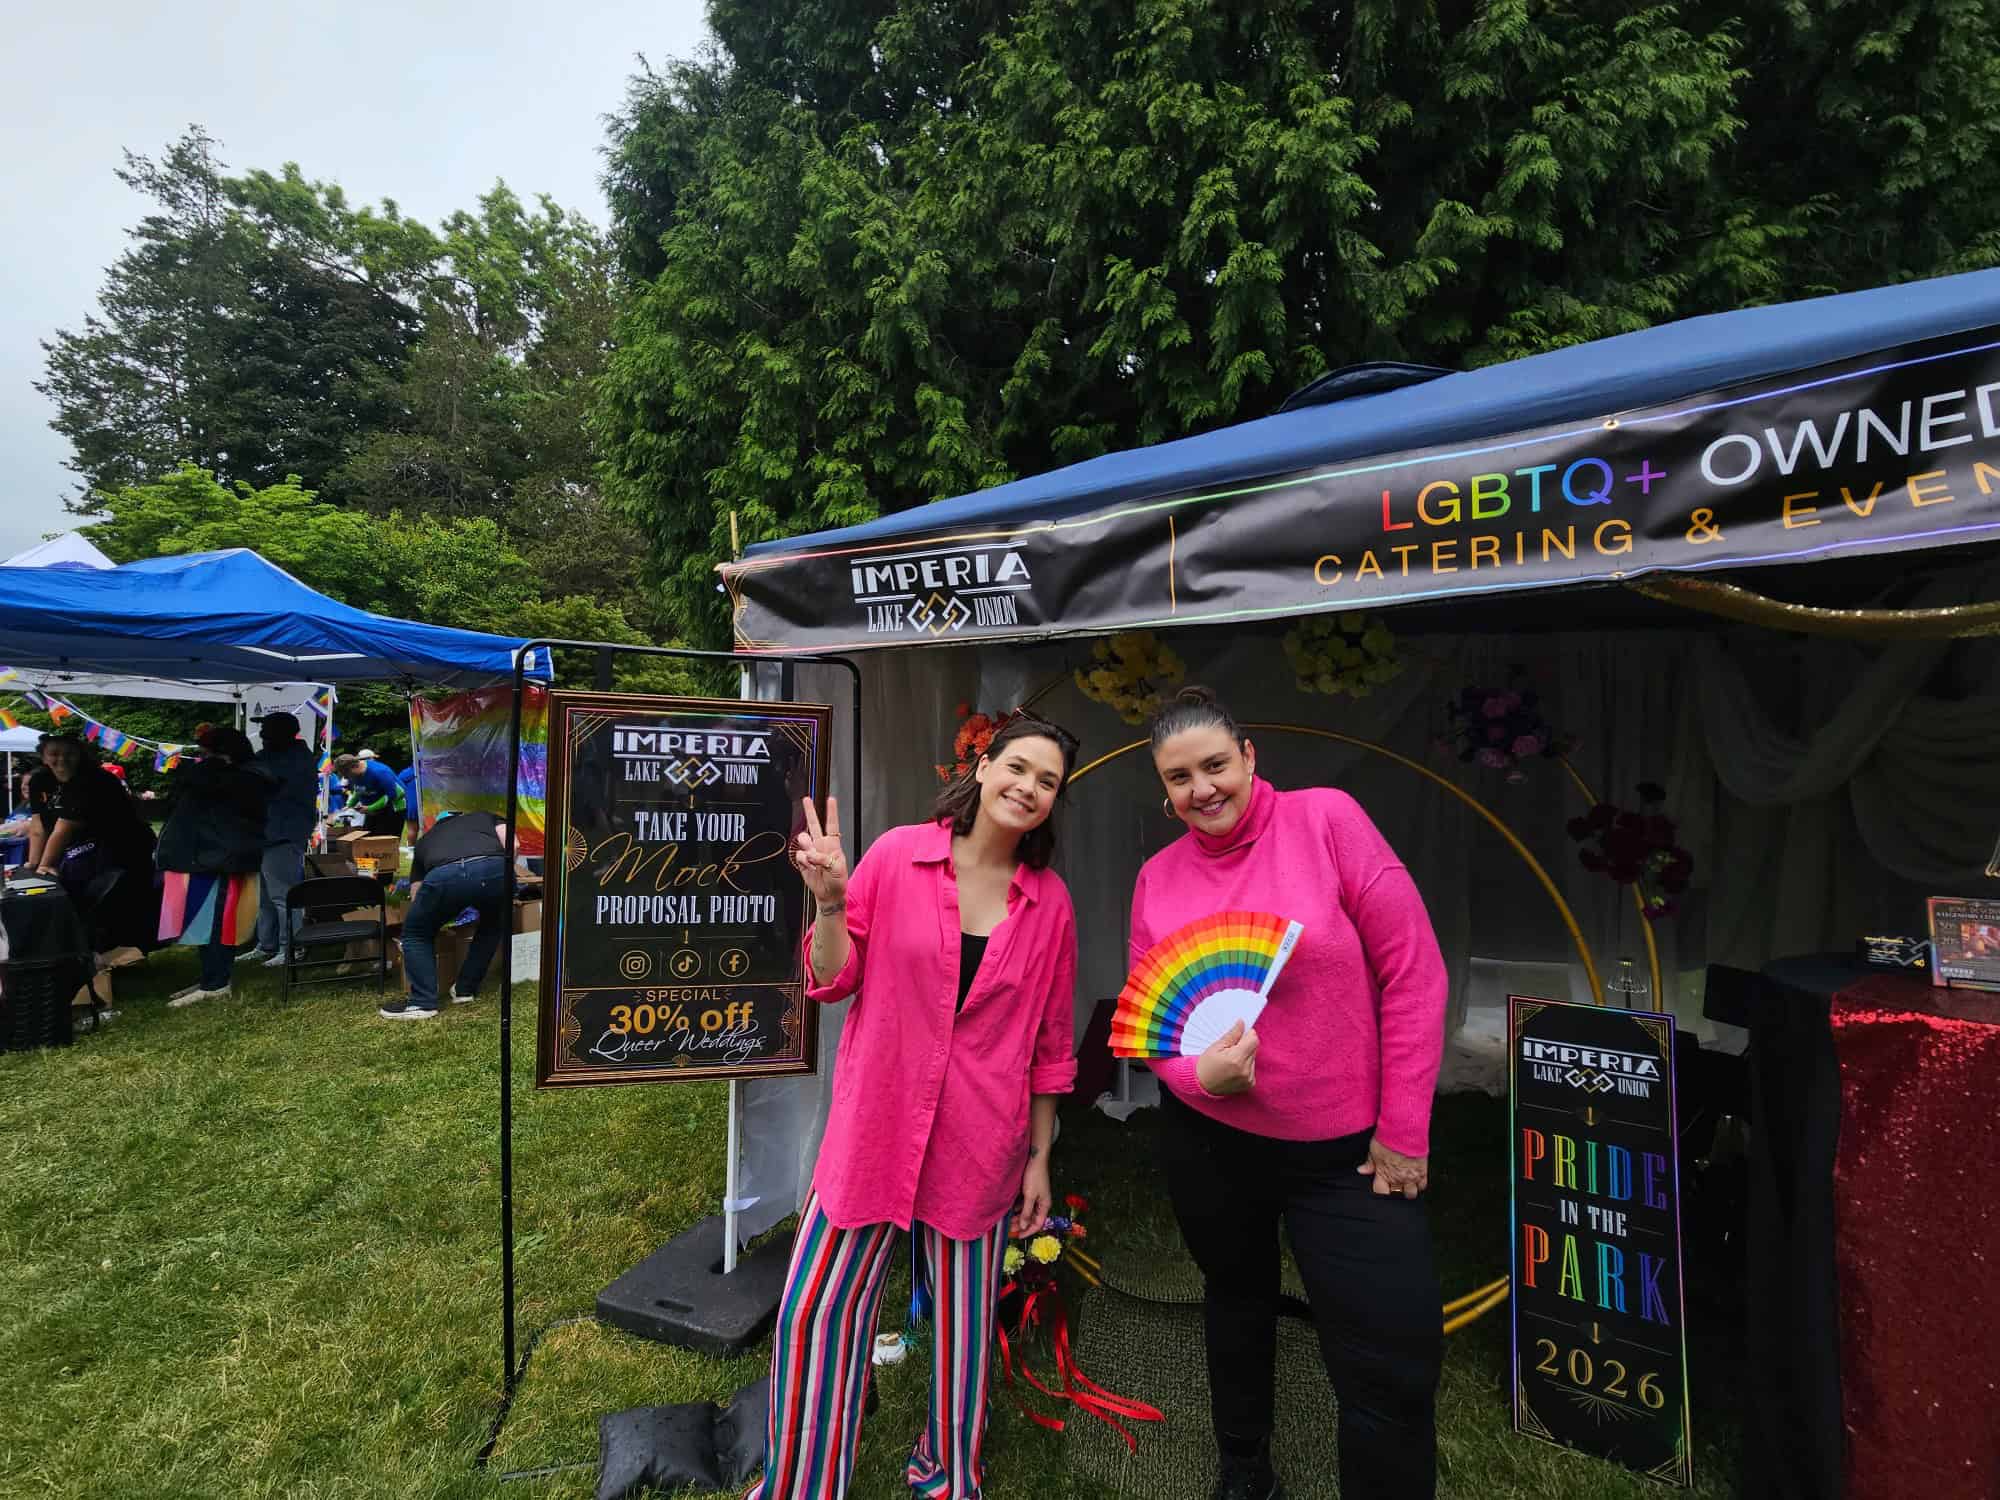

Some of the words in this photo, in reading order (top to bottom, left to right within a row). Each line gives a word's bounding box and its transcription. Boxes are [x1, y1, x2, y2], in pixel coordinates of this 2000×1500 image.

[1381, 457, 1667, 532] LGBTQ+
[1314, 519, 1633, 585] CATERING
[1685, 508, 1726, 545] &
[851, 552, 1032, 594] IMPERIA
[867, 604, 903, 633] LAKE
[974, 595, 1018, 626] UNION
[613, 731, 771, 757] IMPERIA
[624, 760, 660, 782] LAKE
[724, 764, 760, 785] UNION
[634, 811, 688, 841] TAKE
[696, 812, 746, 842] YOUR
[590, 831, 787, 893] Mock
[595, 895, 701, 925] PROPOSAL
[709, 895, 776, 924] PHOTO
[646, 988, 721, 1002] SPECIAL
[608, 1004, 690, 1034] 30%
[700, 1001, 754, 1031] off
[589, 1027, 666, 1062] Queer
[669, 1019, 768, 1065] Weddings
[1522, 1040, 1660, 1077] IMPERIA
[1533, 1063, 1562, 1083] LAKE
[1617, 1078, 1649, 1098] UNION
[1522, 1128, 1667, 1210] PRIDE
[1559, 1199, 1578, 1225] IN
[1587, 1206, 1627, 1238] THE
[1522, 1223, 1671, 1326] PARK
[1535, 1338, 1665, 1409] 2026
